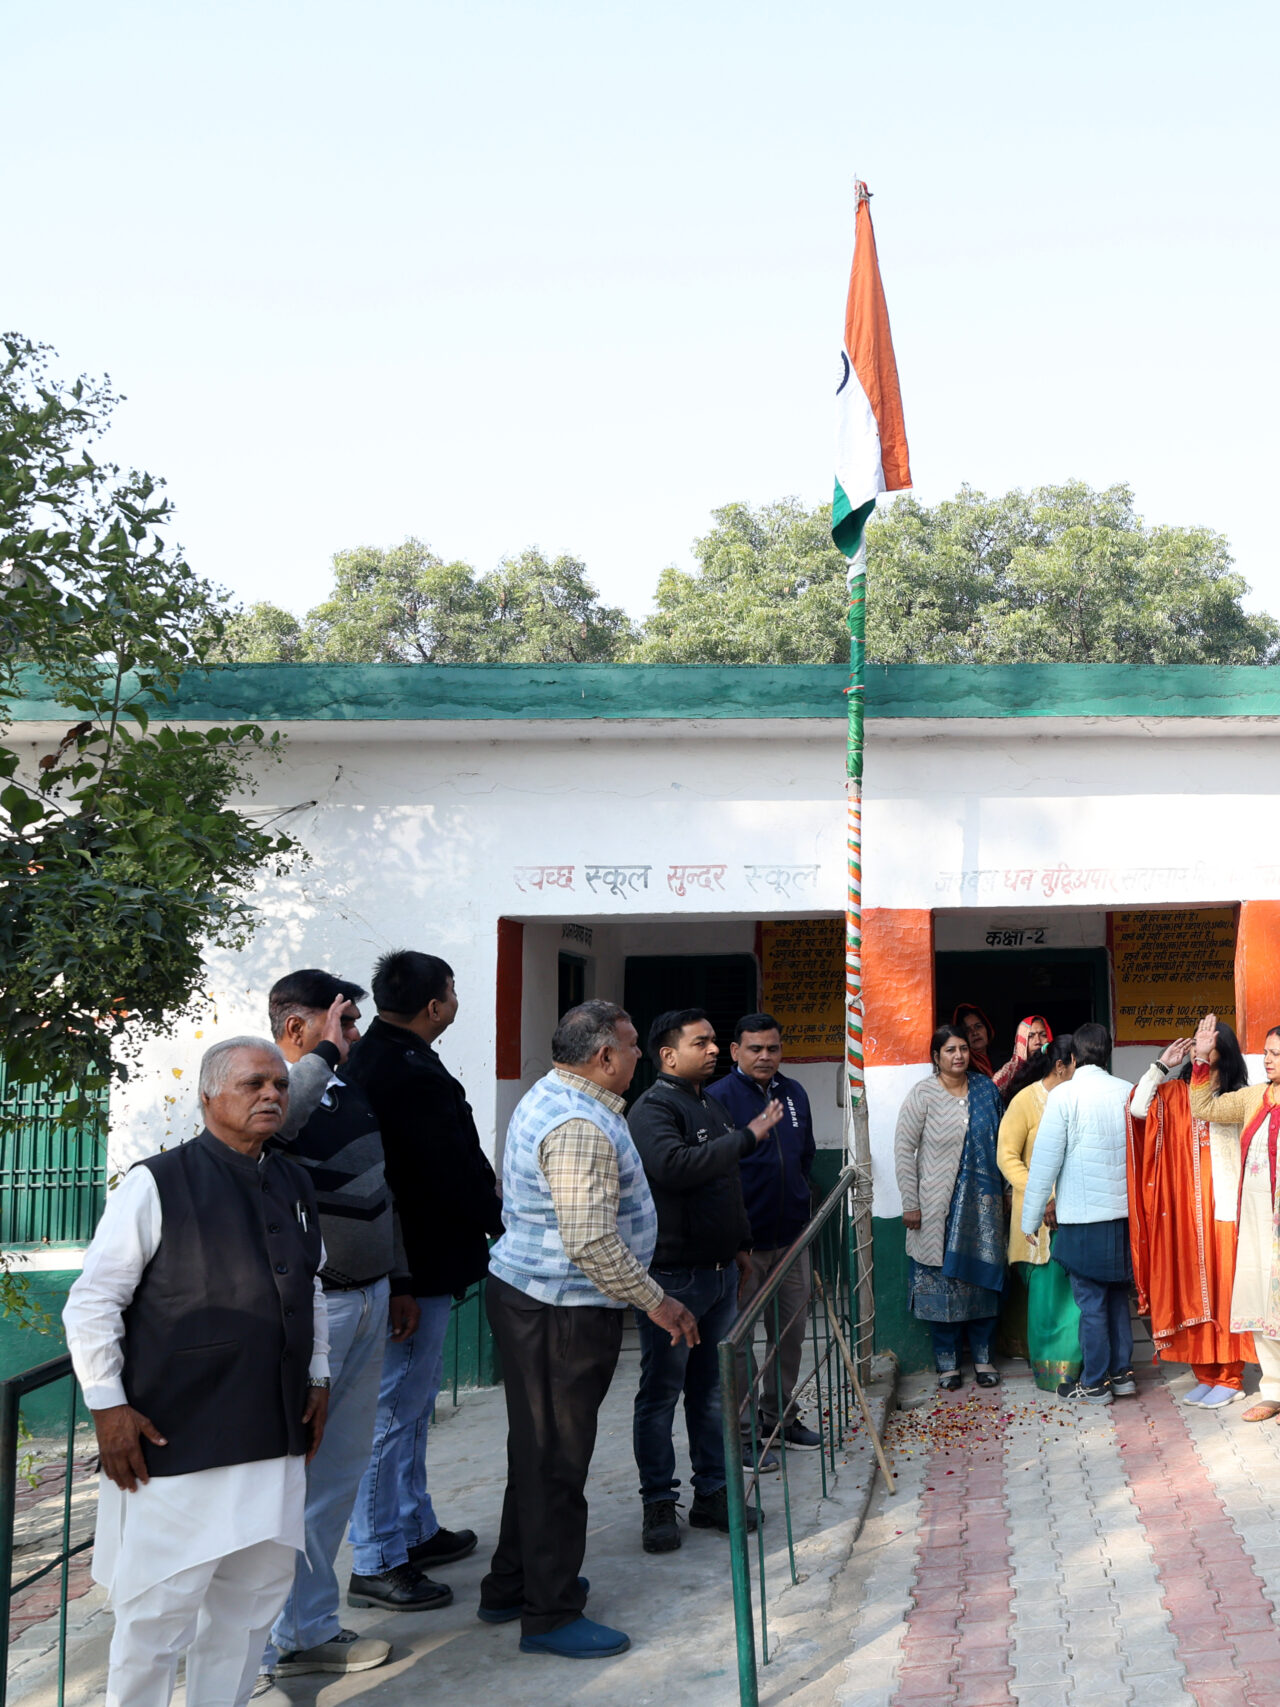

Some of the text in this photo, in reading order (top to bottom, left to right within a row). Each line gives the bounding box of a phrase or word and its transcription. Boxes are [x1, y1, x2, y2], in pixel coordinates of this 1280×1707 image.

[584, 864, 653, 900] स्कूल
[667, 864, 728, 897] सुन्दर
[786, 1096, 799, 1128] JORDAN
